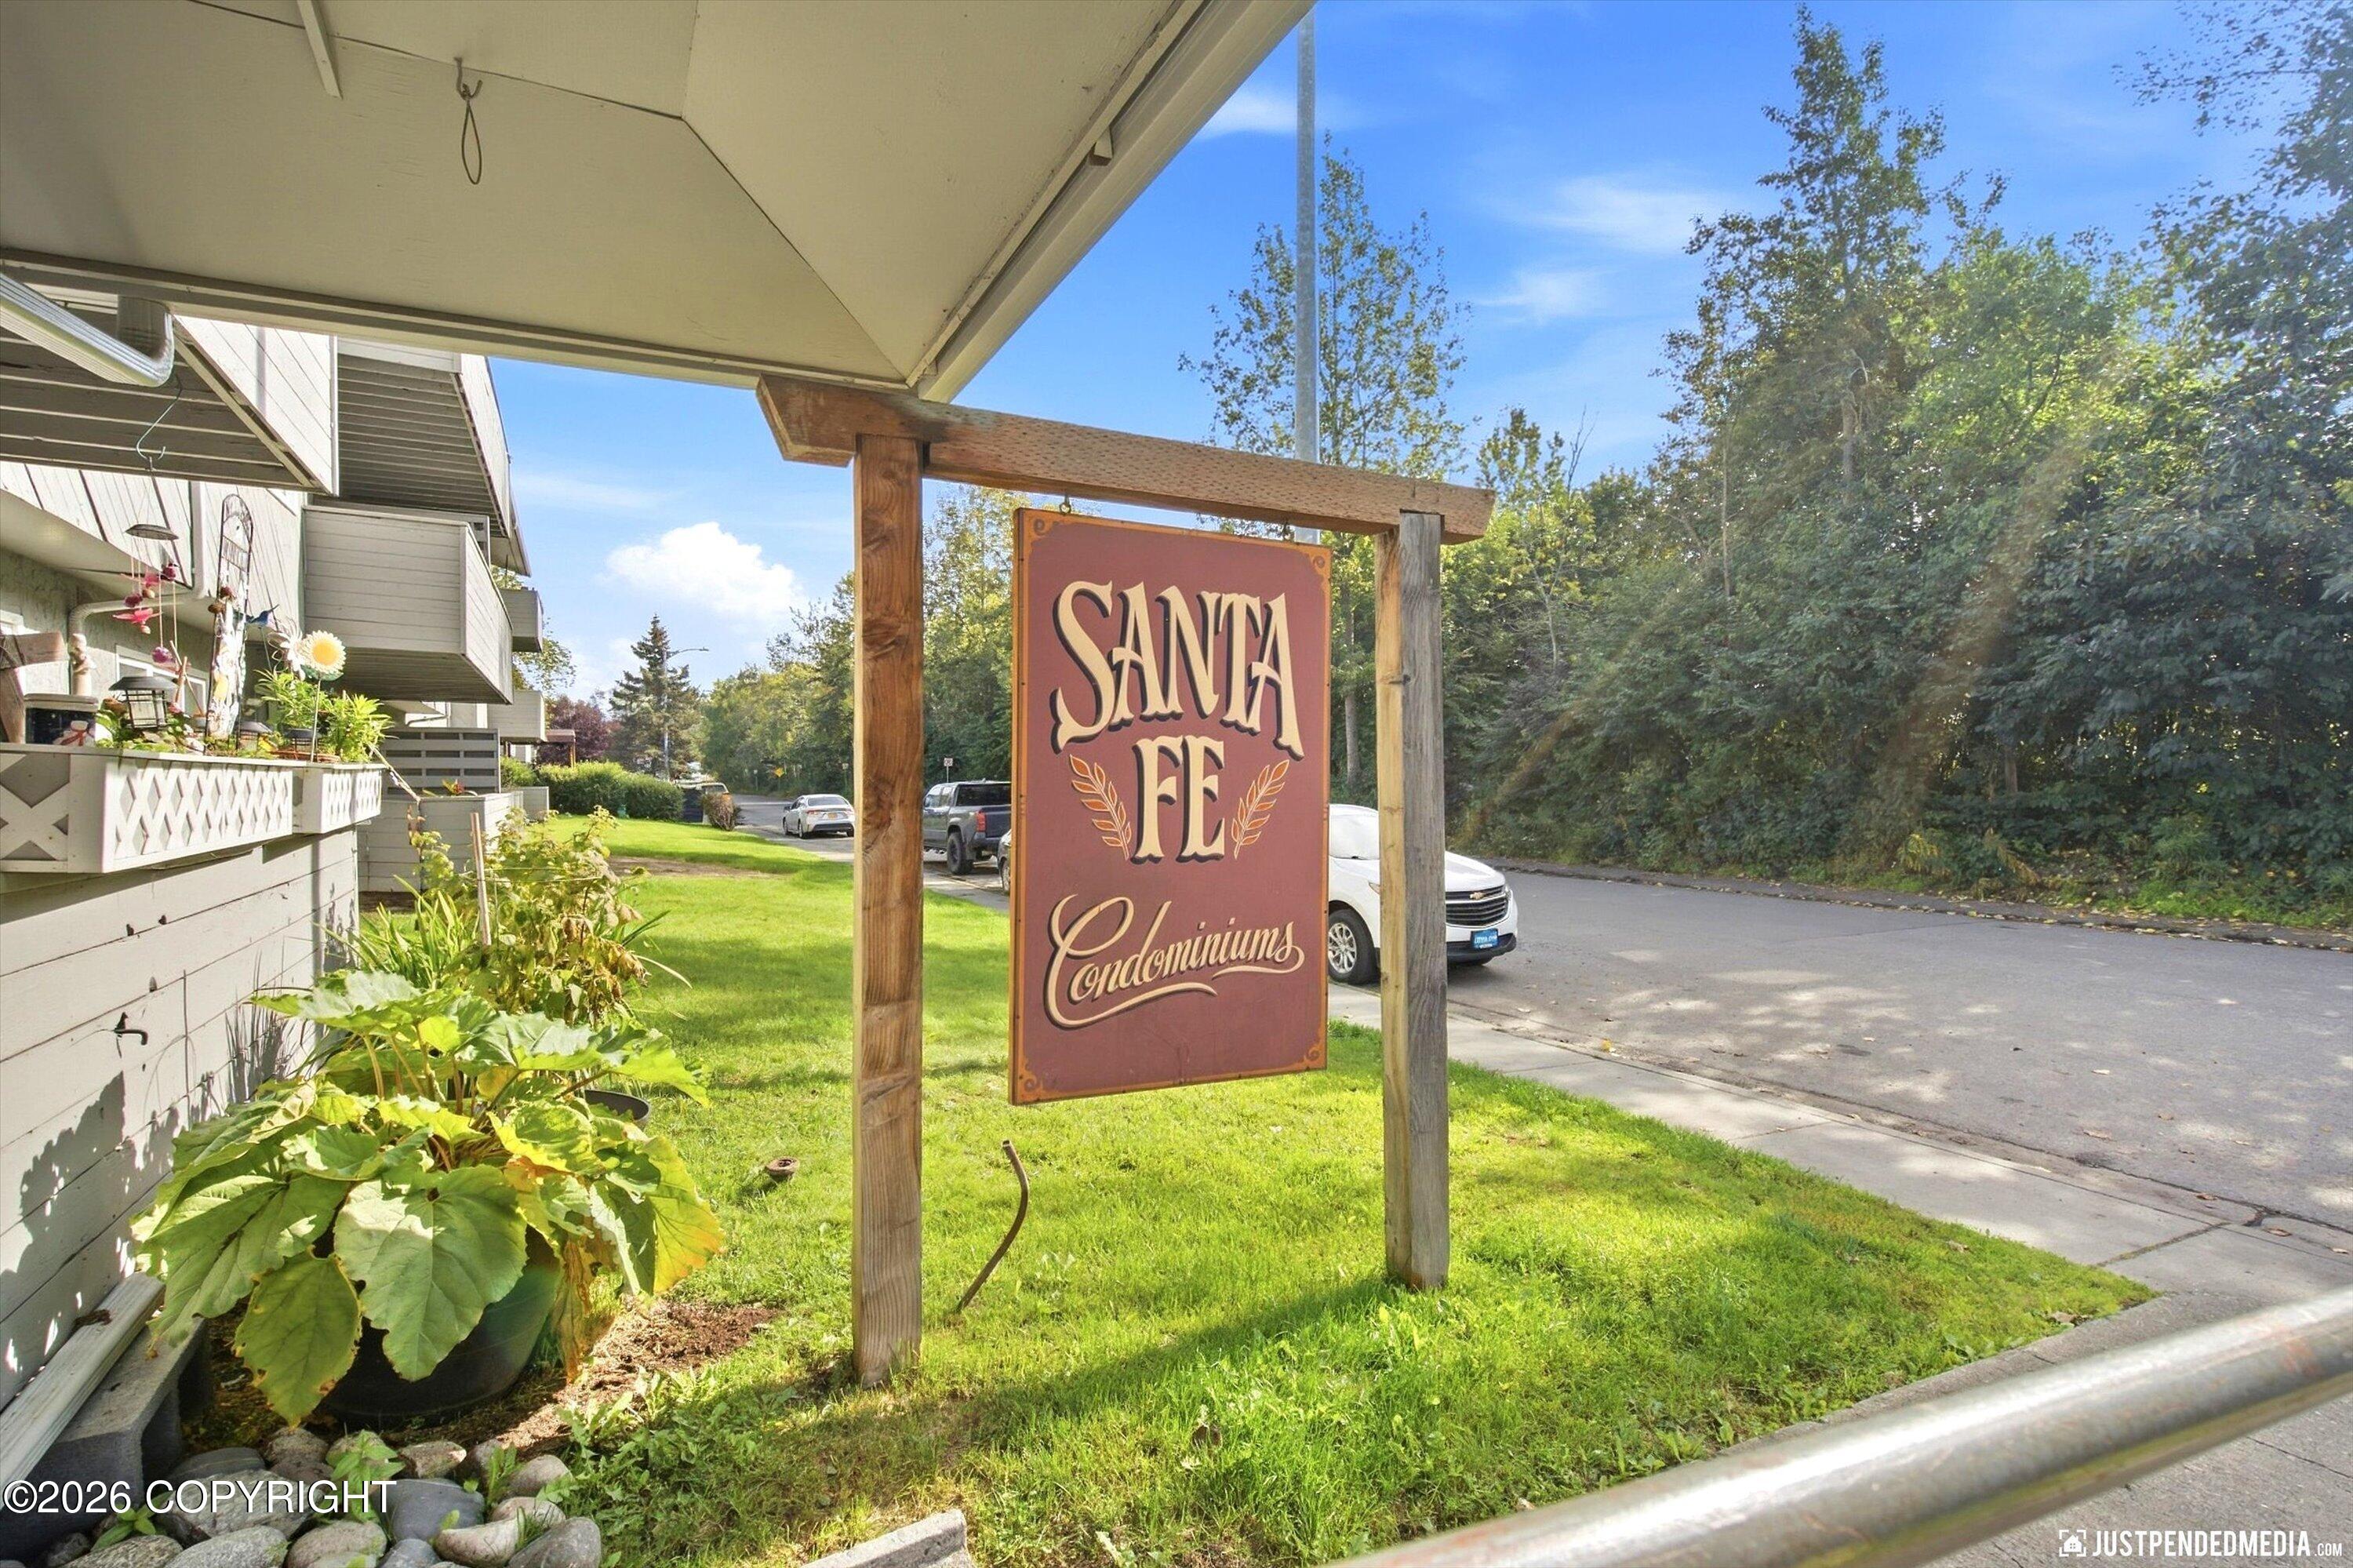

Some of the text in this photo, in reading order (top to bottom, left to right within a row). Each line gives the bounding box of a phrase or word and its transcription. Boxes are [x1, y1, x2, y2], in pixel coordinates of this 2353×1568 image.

[1050, 580, 1304, 761] SANTA
[1131, 735, 1224, 864] FE
[1044, 894, 1304, 1030] Condominiums
